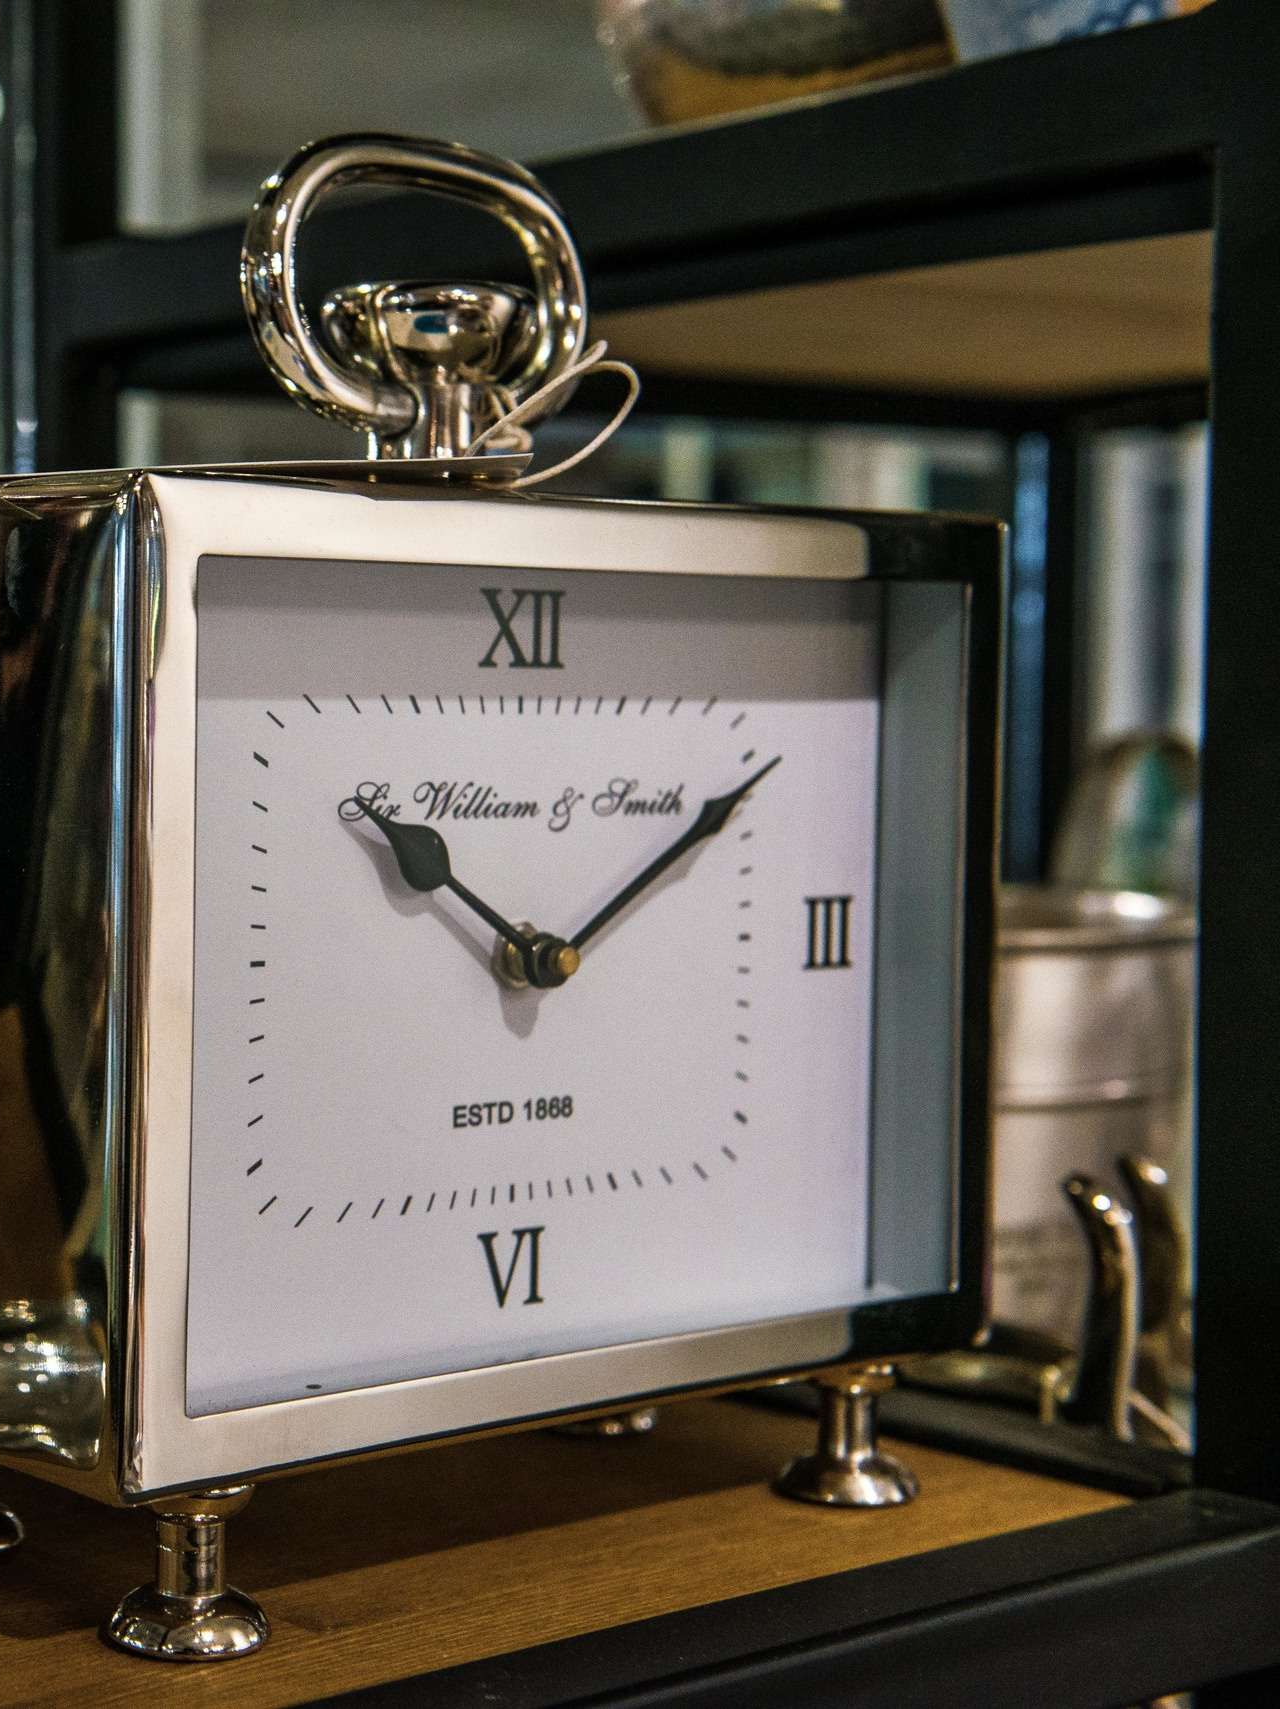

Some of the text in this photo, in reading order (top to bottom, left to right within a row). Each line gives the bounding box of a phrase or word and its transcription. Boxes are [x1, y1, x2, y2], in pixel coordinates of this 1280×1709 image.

[478, 587, 566, 669] XII
[337, 775, 685, 833] Sir William & Smith
[801, 893, 854, 972] III
[452, 1095, 574, 1130] ESTD 1868
[476, 1225, 546, 1309] VI
